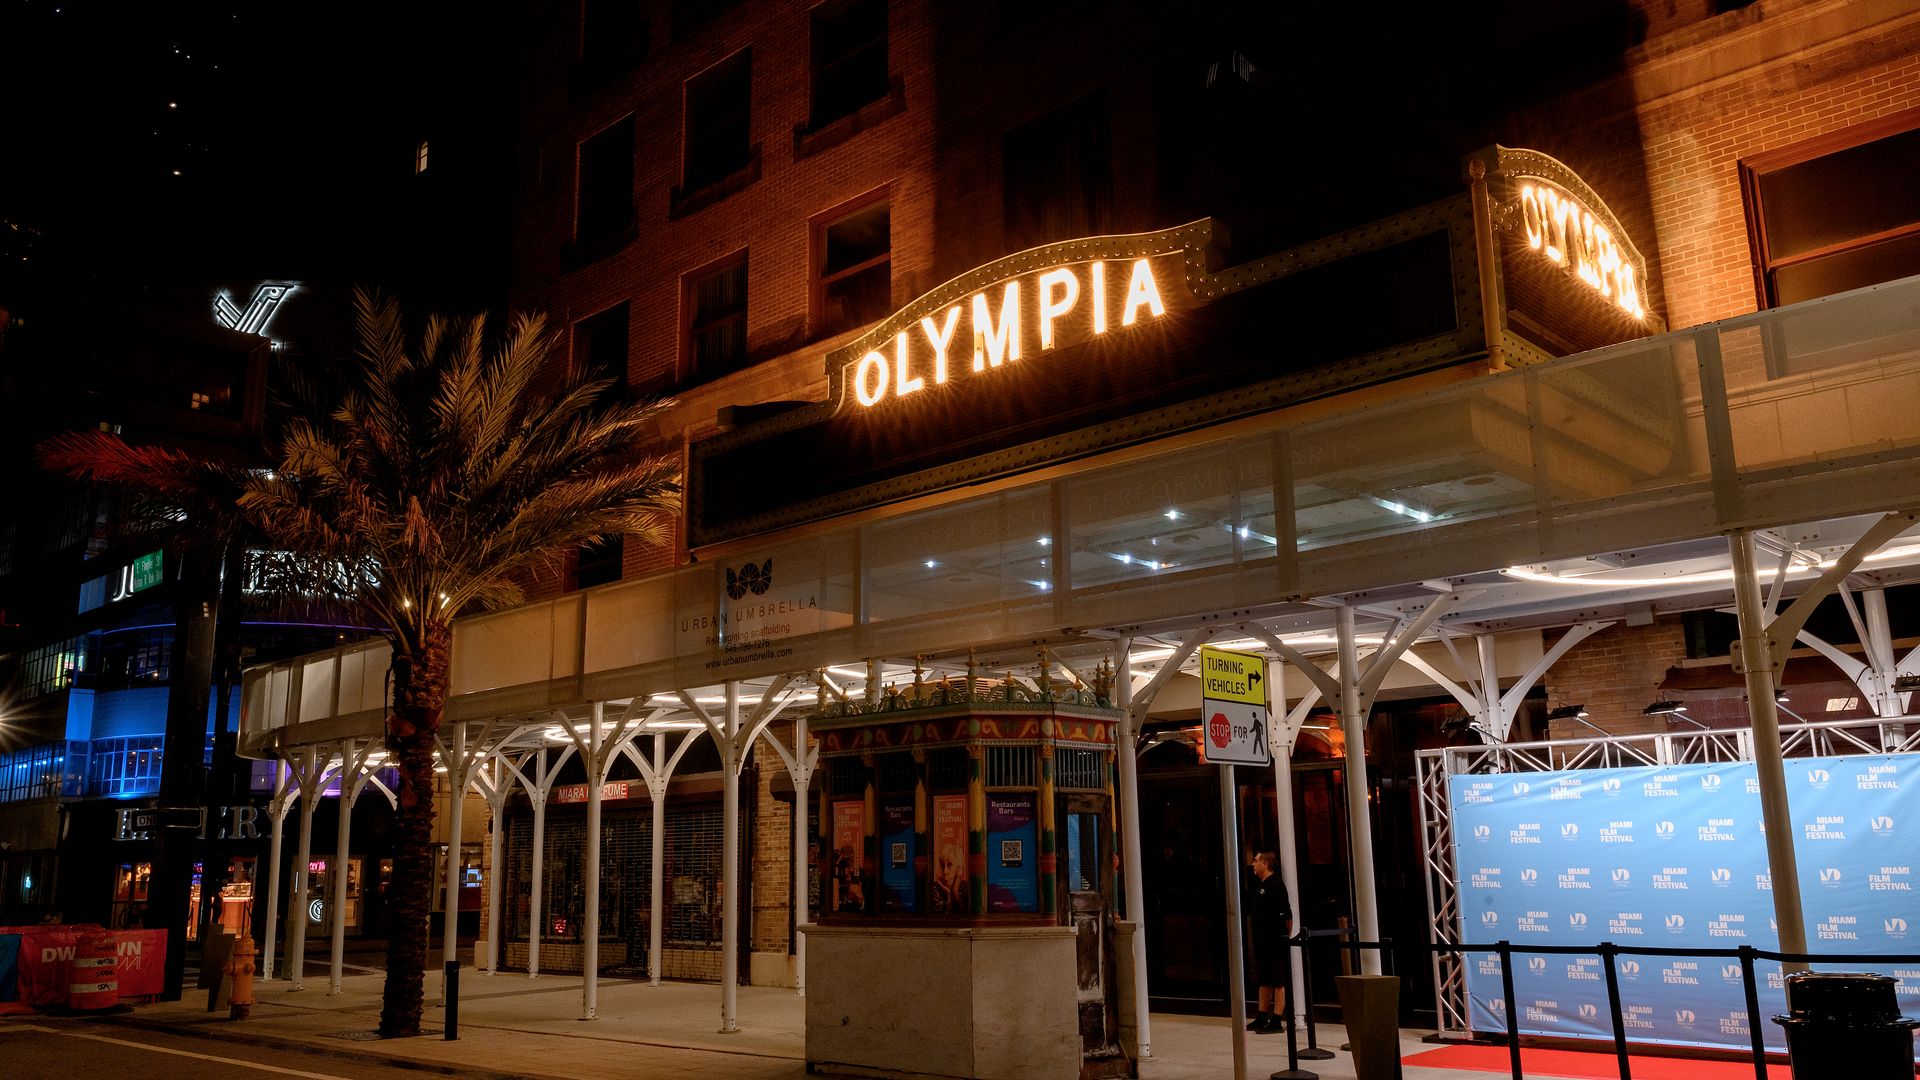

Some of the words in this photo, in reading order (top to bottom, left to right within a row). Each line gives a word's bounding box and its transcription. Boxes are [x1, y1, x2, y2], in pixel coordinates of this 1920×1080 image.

[1522, 186, 1644, 319] OLYMPIA
[855, 259, 1165, 407] OLYMPIA
[681, 613, 728, 632] URBAN
[736, 595, 817, 622] UMBRELLA
[1206, 657, 1244, 675] TURNING
[1206, 677, 1246, 695] VEHICLES
[1210, 724, 1230, 737] STOP
[1233, 726, 1248, 739] FOR
[1858, 781, 1898, 790] FESTIVAL
[558, 787, 585, 800] MIARA
[1644, 789, 1679, 797] FESTIVAL
[999, 807, 1014, 815] Bars
[1870, 882, 1911, 890] FESTIVAL
[1829, 916, 1856, 924] MIAMI
[1819, 932, 1858, 940] FESTIVAL
[1673, 962, 1697, 970] MIAMI
[1568, 972, 1600, 980] FESTIVAL
[1629, 1006, 1652, 1014] MIAMI
[1527, 1014, 1558, 1022] FESTIVAL
